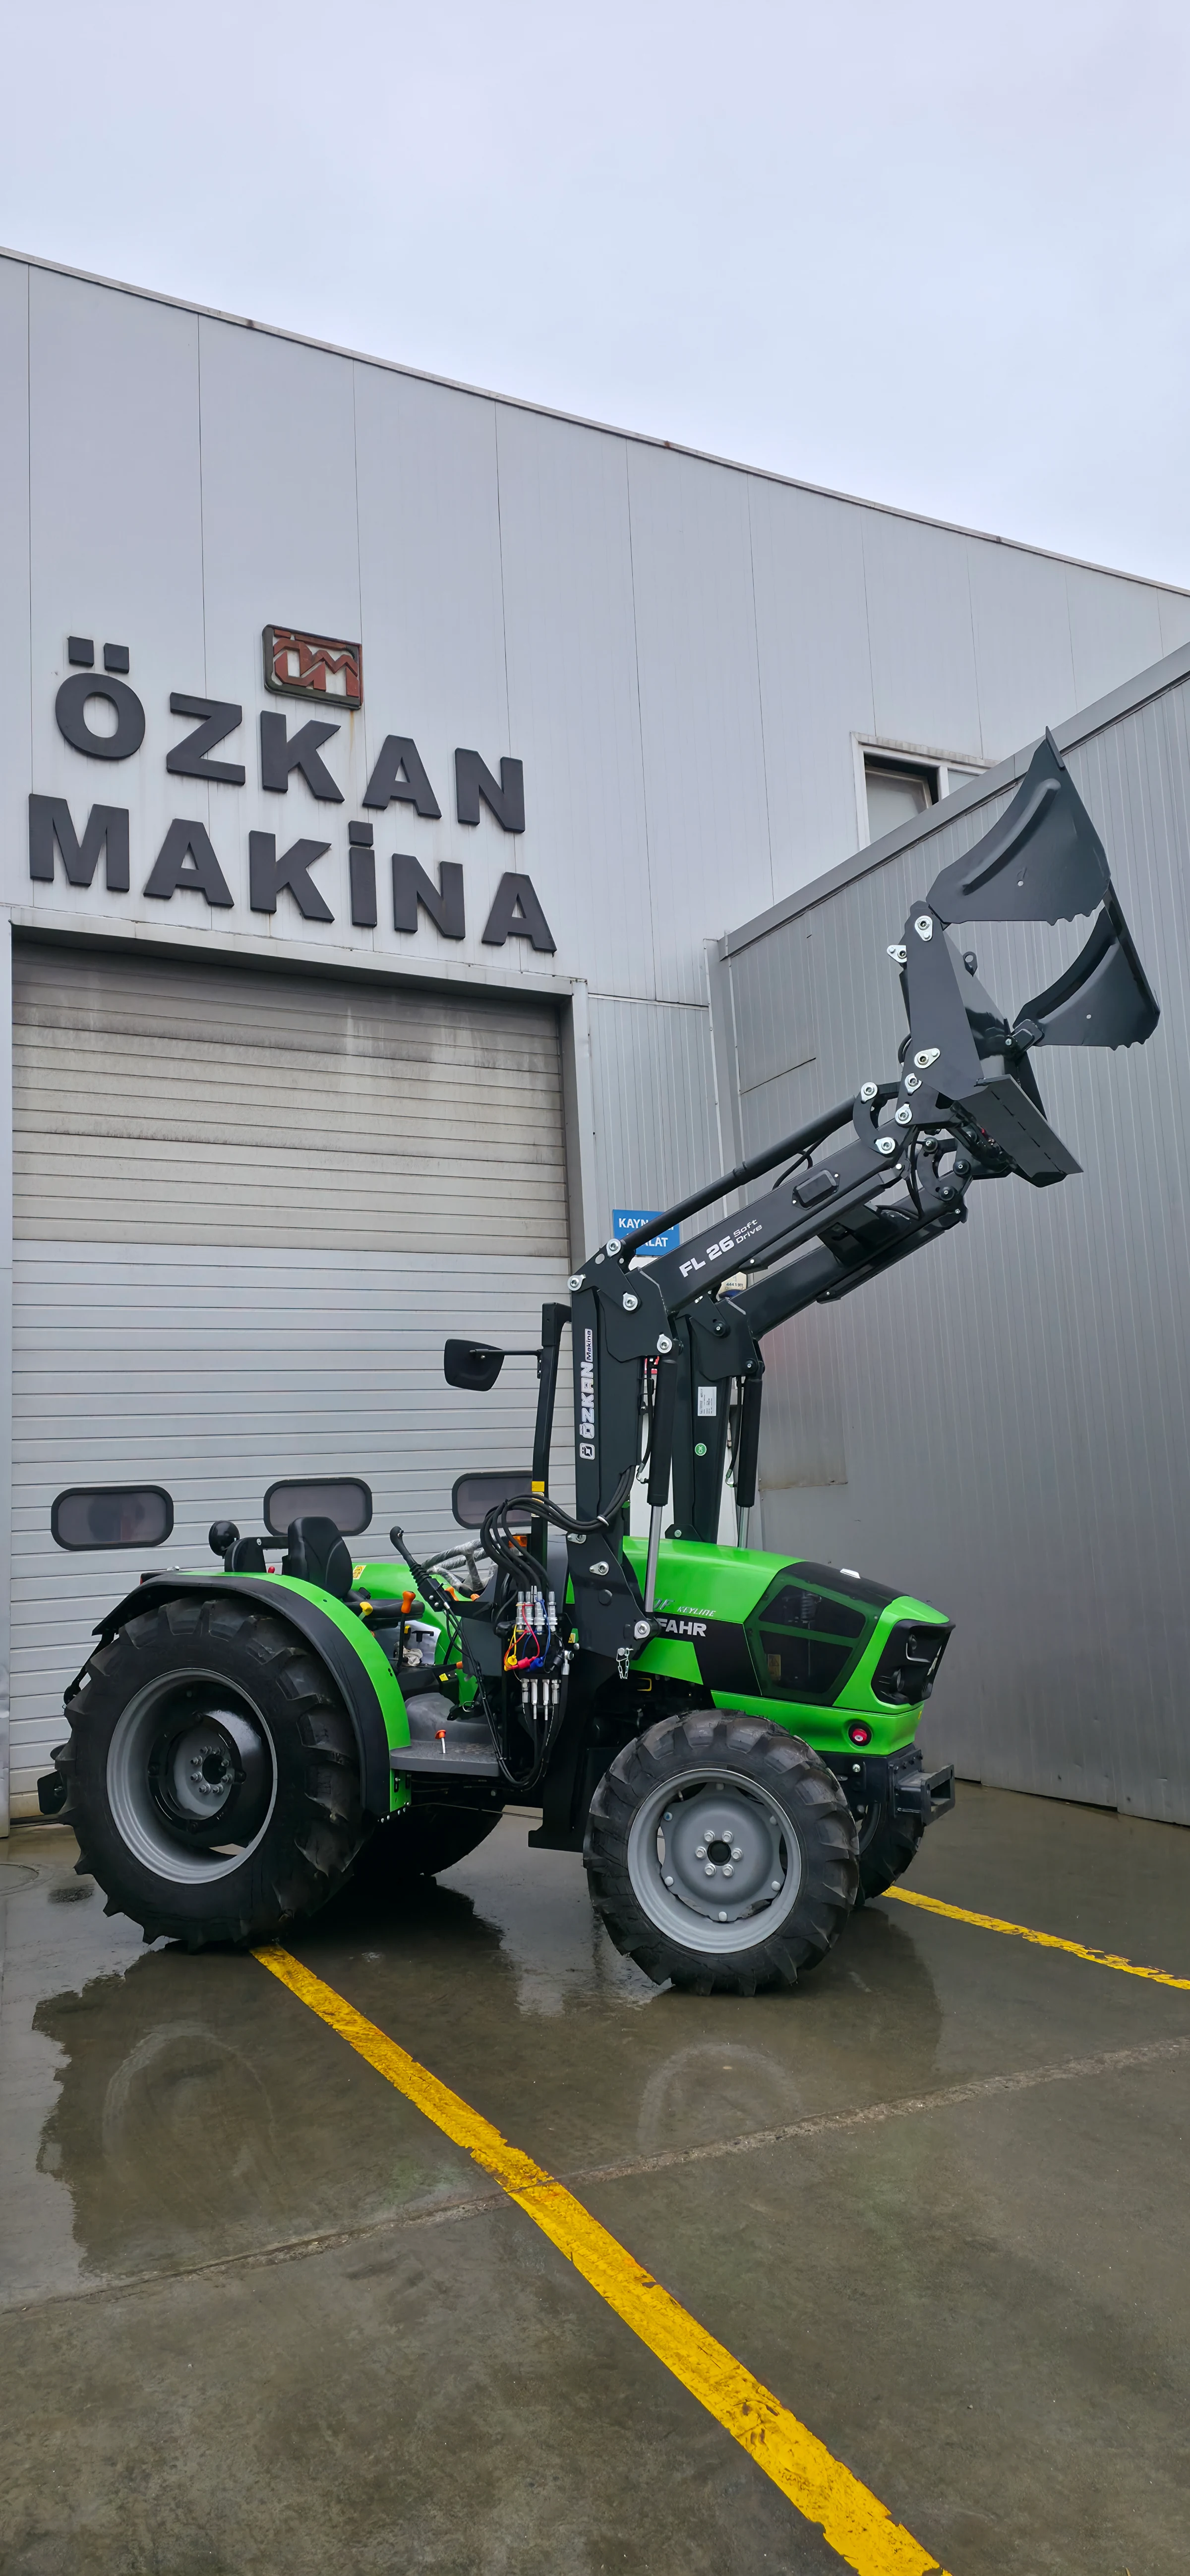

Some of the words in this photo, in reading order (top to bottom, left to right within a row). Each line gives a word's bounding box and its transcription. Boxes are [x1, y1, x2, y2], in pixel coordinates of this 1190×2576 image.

[56, 635, 525, 833] ÖZKAN
[29, 793, 557, 953] MAKİNA
[733, 1219, 758, 1237] Soft
[736, 1225, 763, 1244] Drive
[679, 1258, 706, 1277] FL
[706, 1236, 734, 1261] 26
[580, 1362, 595, 1439] ÖZKAN
[677, 1606, 716, 1617] KEYLINE
